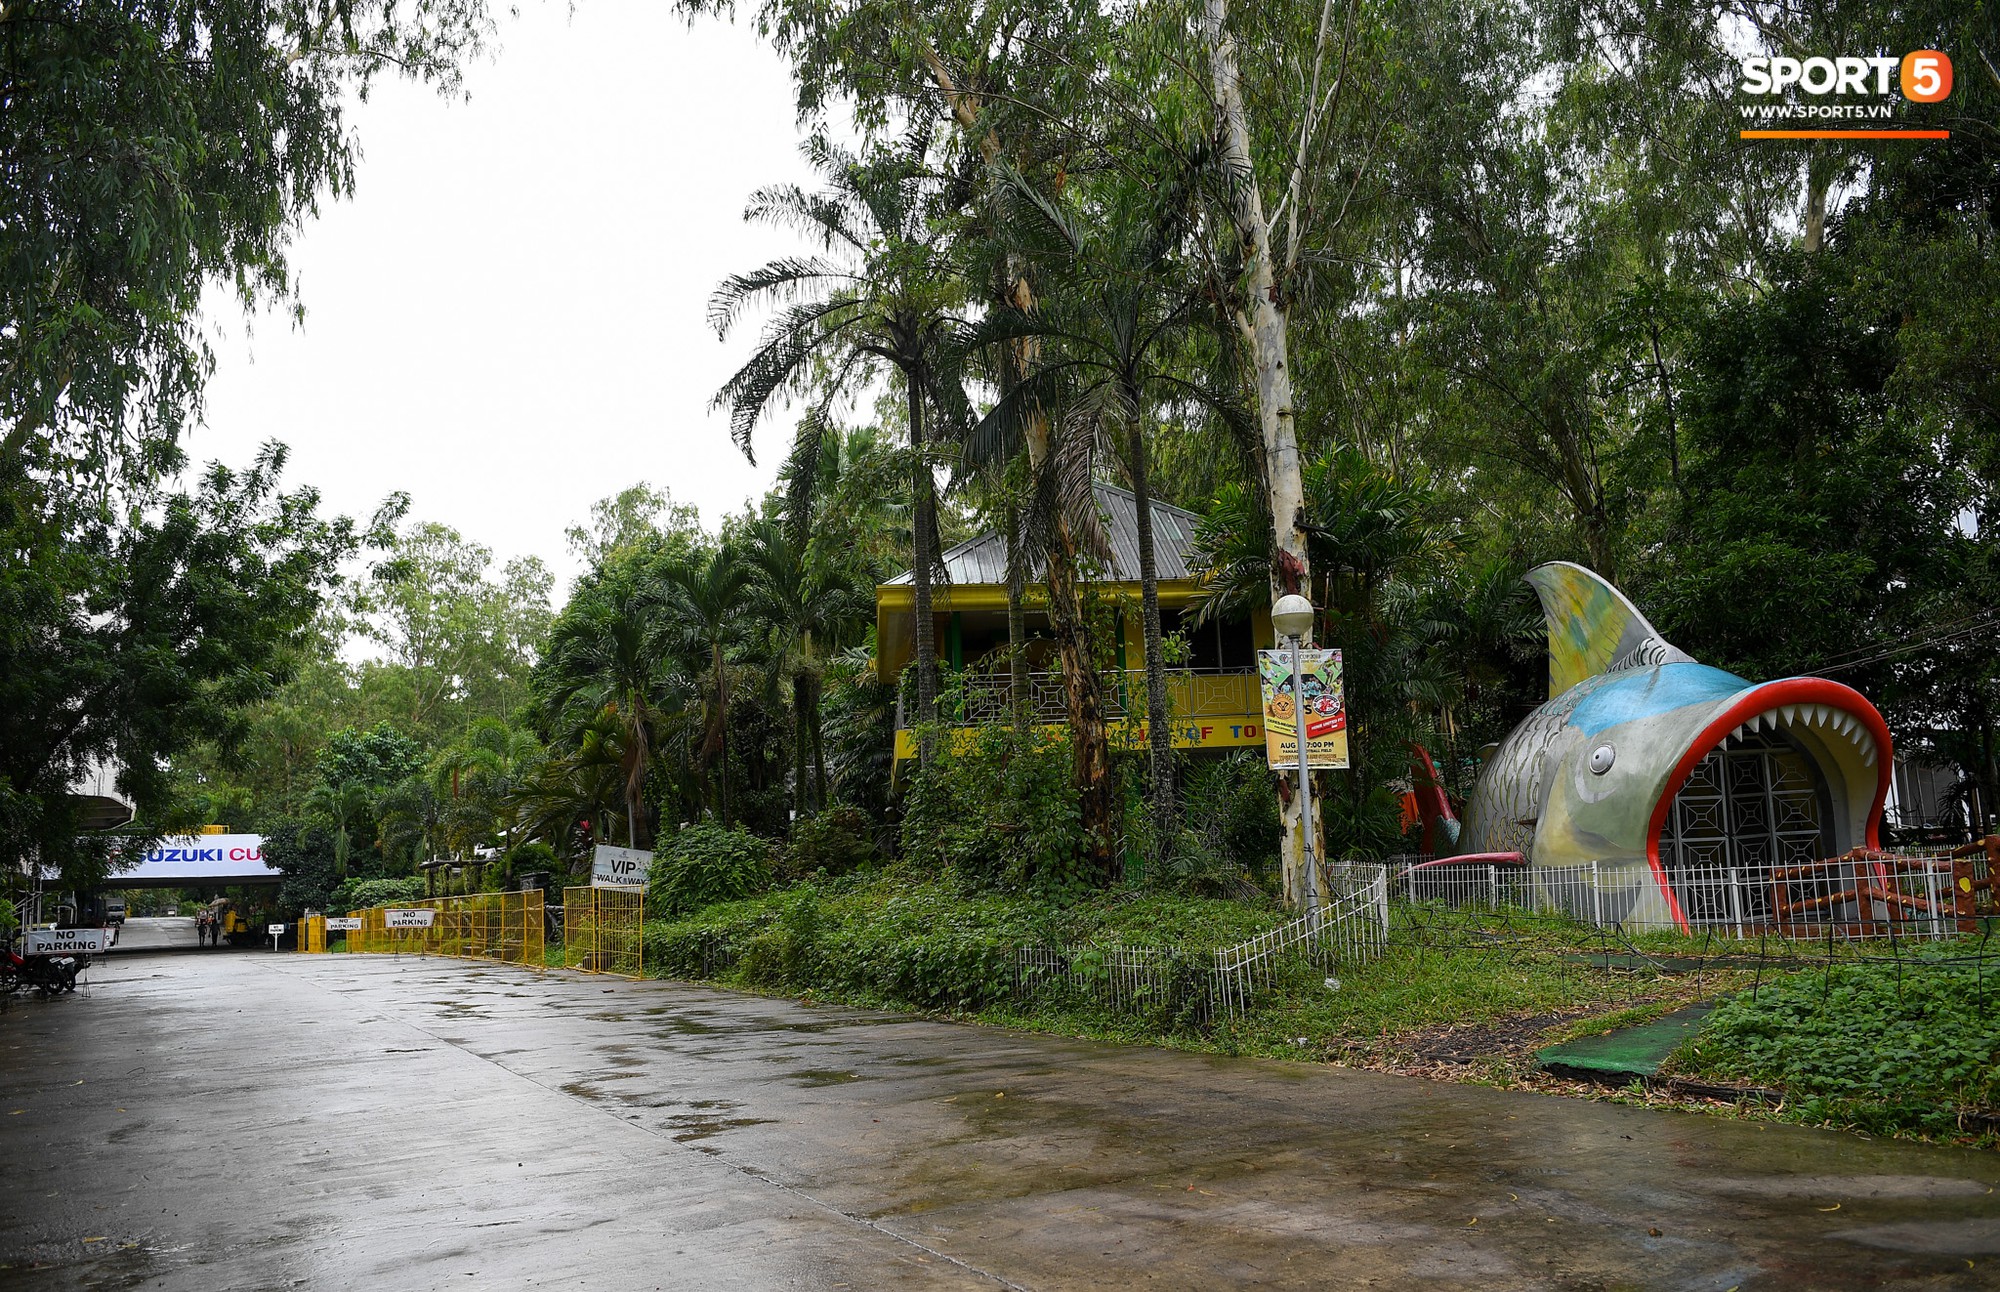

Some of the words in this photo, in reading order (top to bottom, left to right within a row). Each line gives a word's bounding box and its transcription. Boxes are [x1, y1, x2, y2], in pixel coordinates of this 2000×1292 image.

[1303, 704, 1312, 715] S
[1306, 741, 1322, 749] 7:00
[229, 848, 267, 861] CU
[611, 859, 636, 875] VIP
[597, 874, 623, 884] WALK
[627, 877, 646, 885] WAY
[55, 930, 76, 940] NO
[36, 941, 97, 952] PARKING
